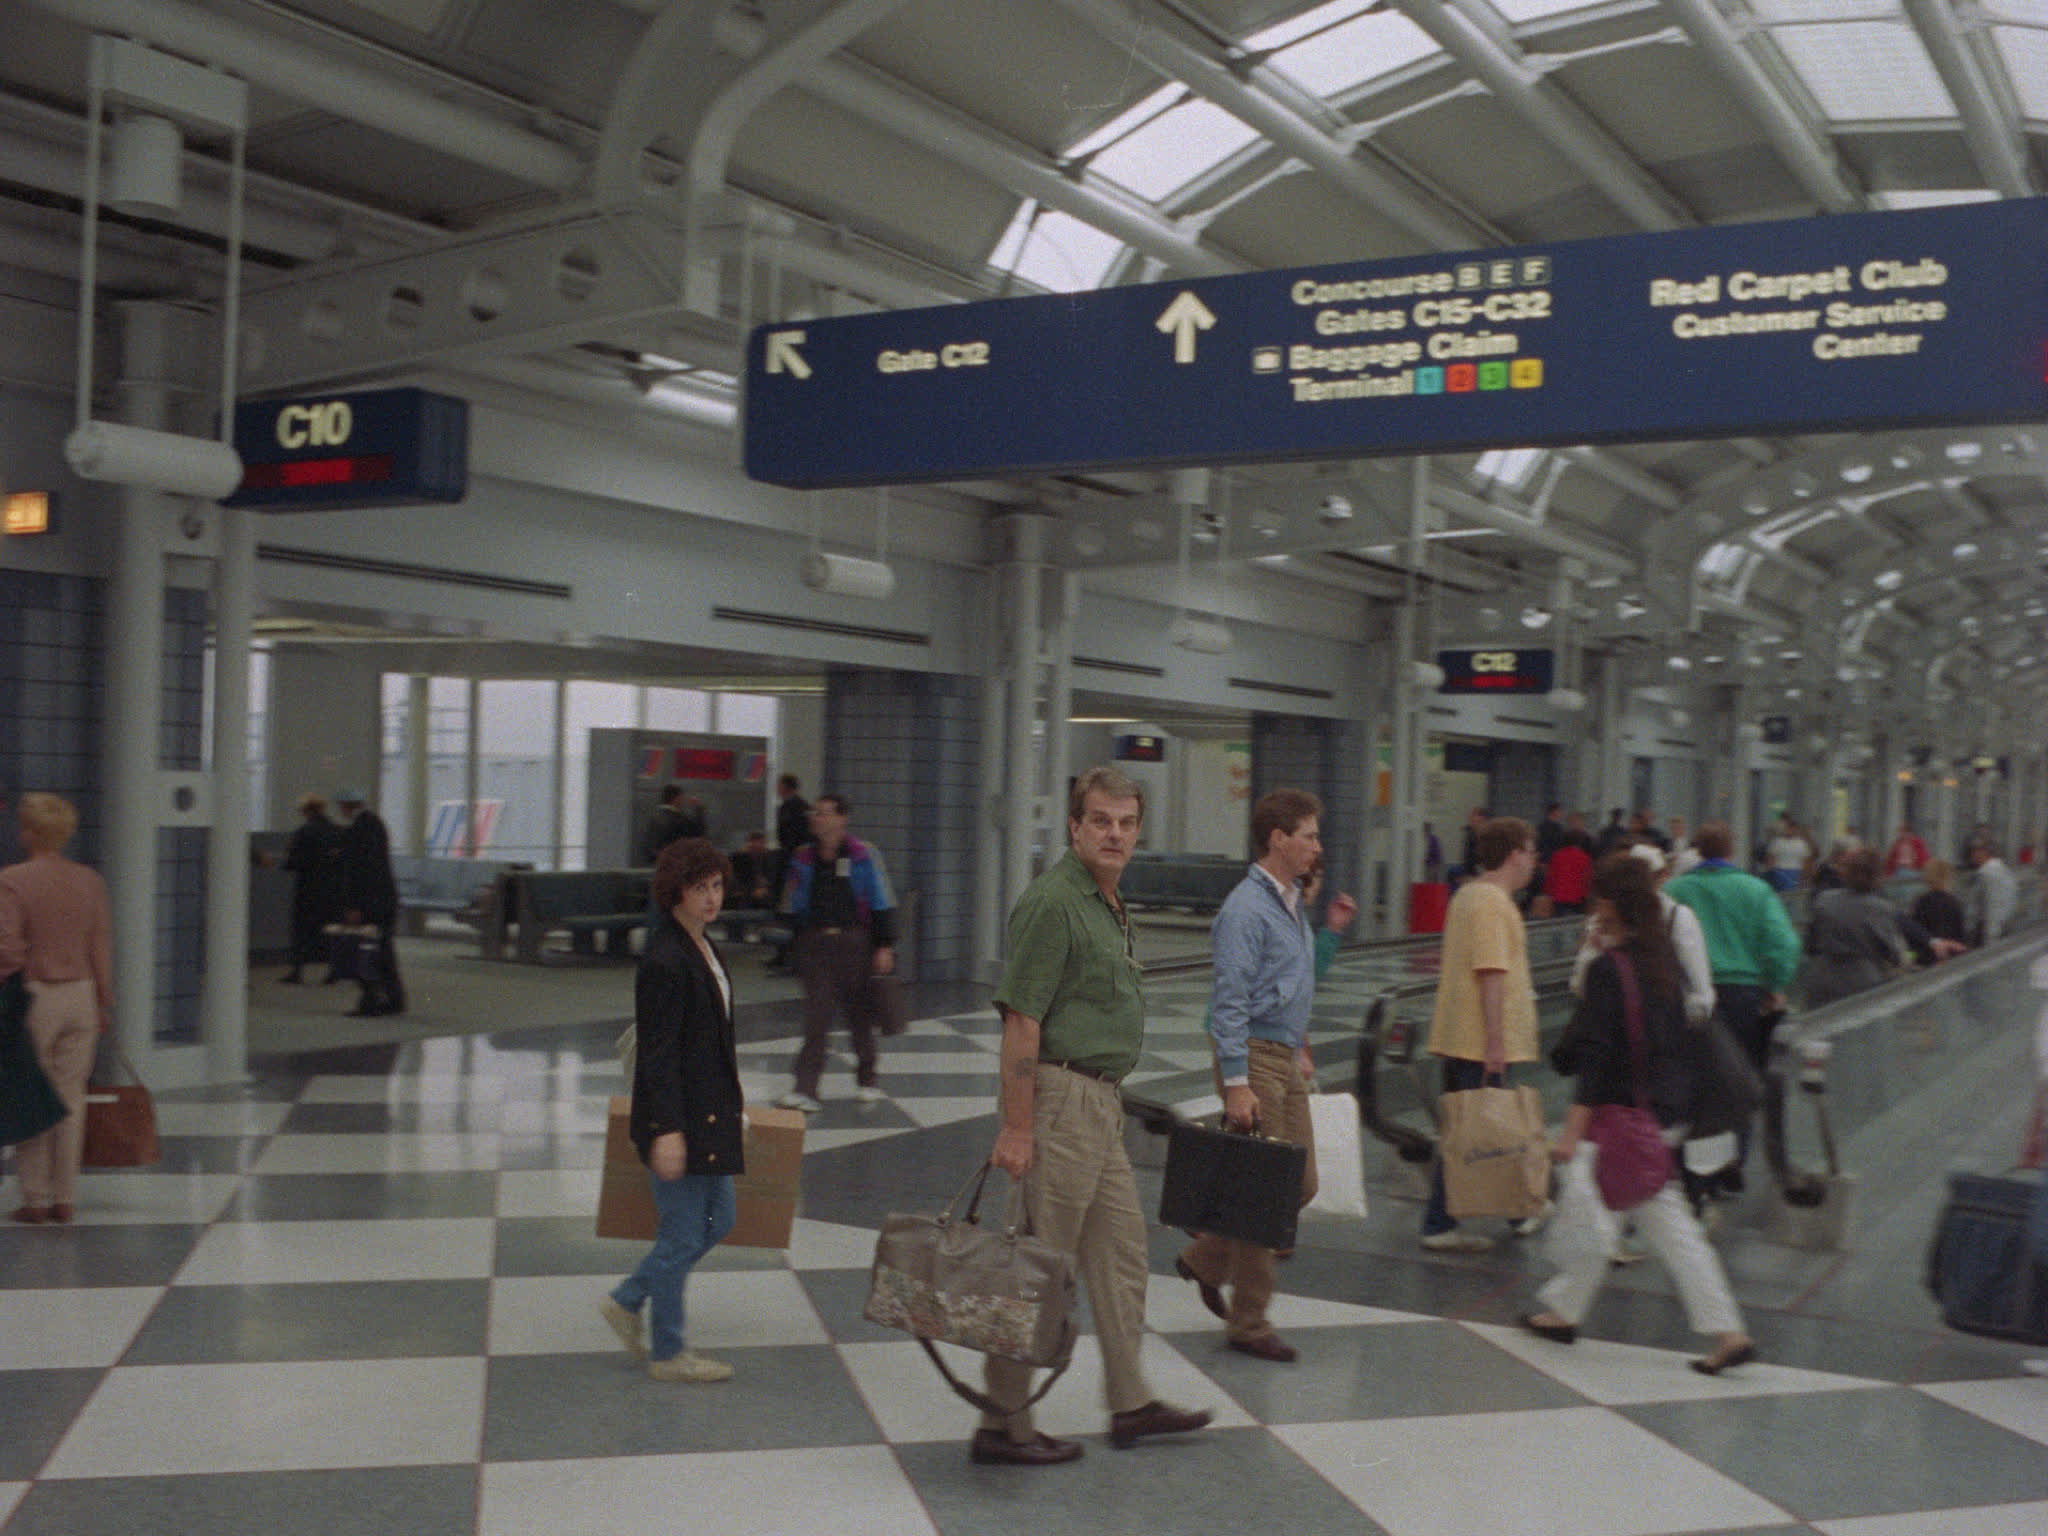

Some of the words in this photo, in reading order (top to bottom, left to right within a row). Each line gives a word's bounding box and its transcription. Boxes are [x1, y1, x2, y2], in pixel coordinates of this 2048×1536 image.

[1291, 272, 1454, 305] Concourse
[1490, 263, 1512, 284] E
[1523, 260, 1545, 281] F
[1650, 276, 1720, 306] Red
[1728, 266, 1850, 301] Carpet
[1860, 258, 1948, 290] Club
[1315, 309, 1407, 335] Gates
[1672, 309, 1820, 338] Customer
[1825, 298, 1947, 327] Service
[877, 349, 938, 374] Gate
[1289, 341, 1422, 372] Baggage
[1427, 330, 1518, 359] Claim
[1812, 331, 1923, 360] Center
[1290, 369, 1414, 401] Terminal
[276, 401, 352, 448] C10
